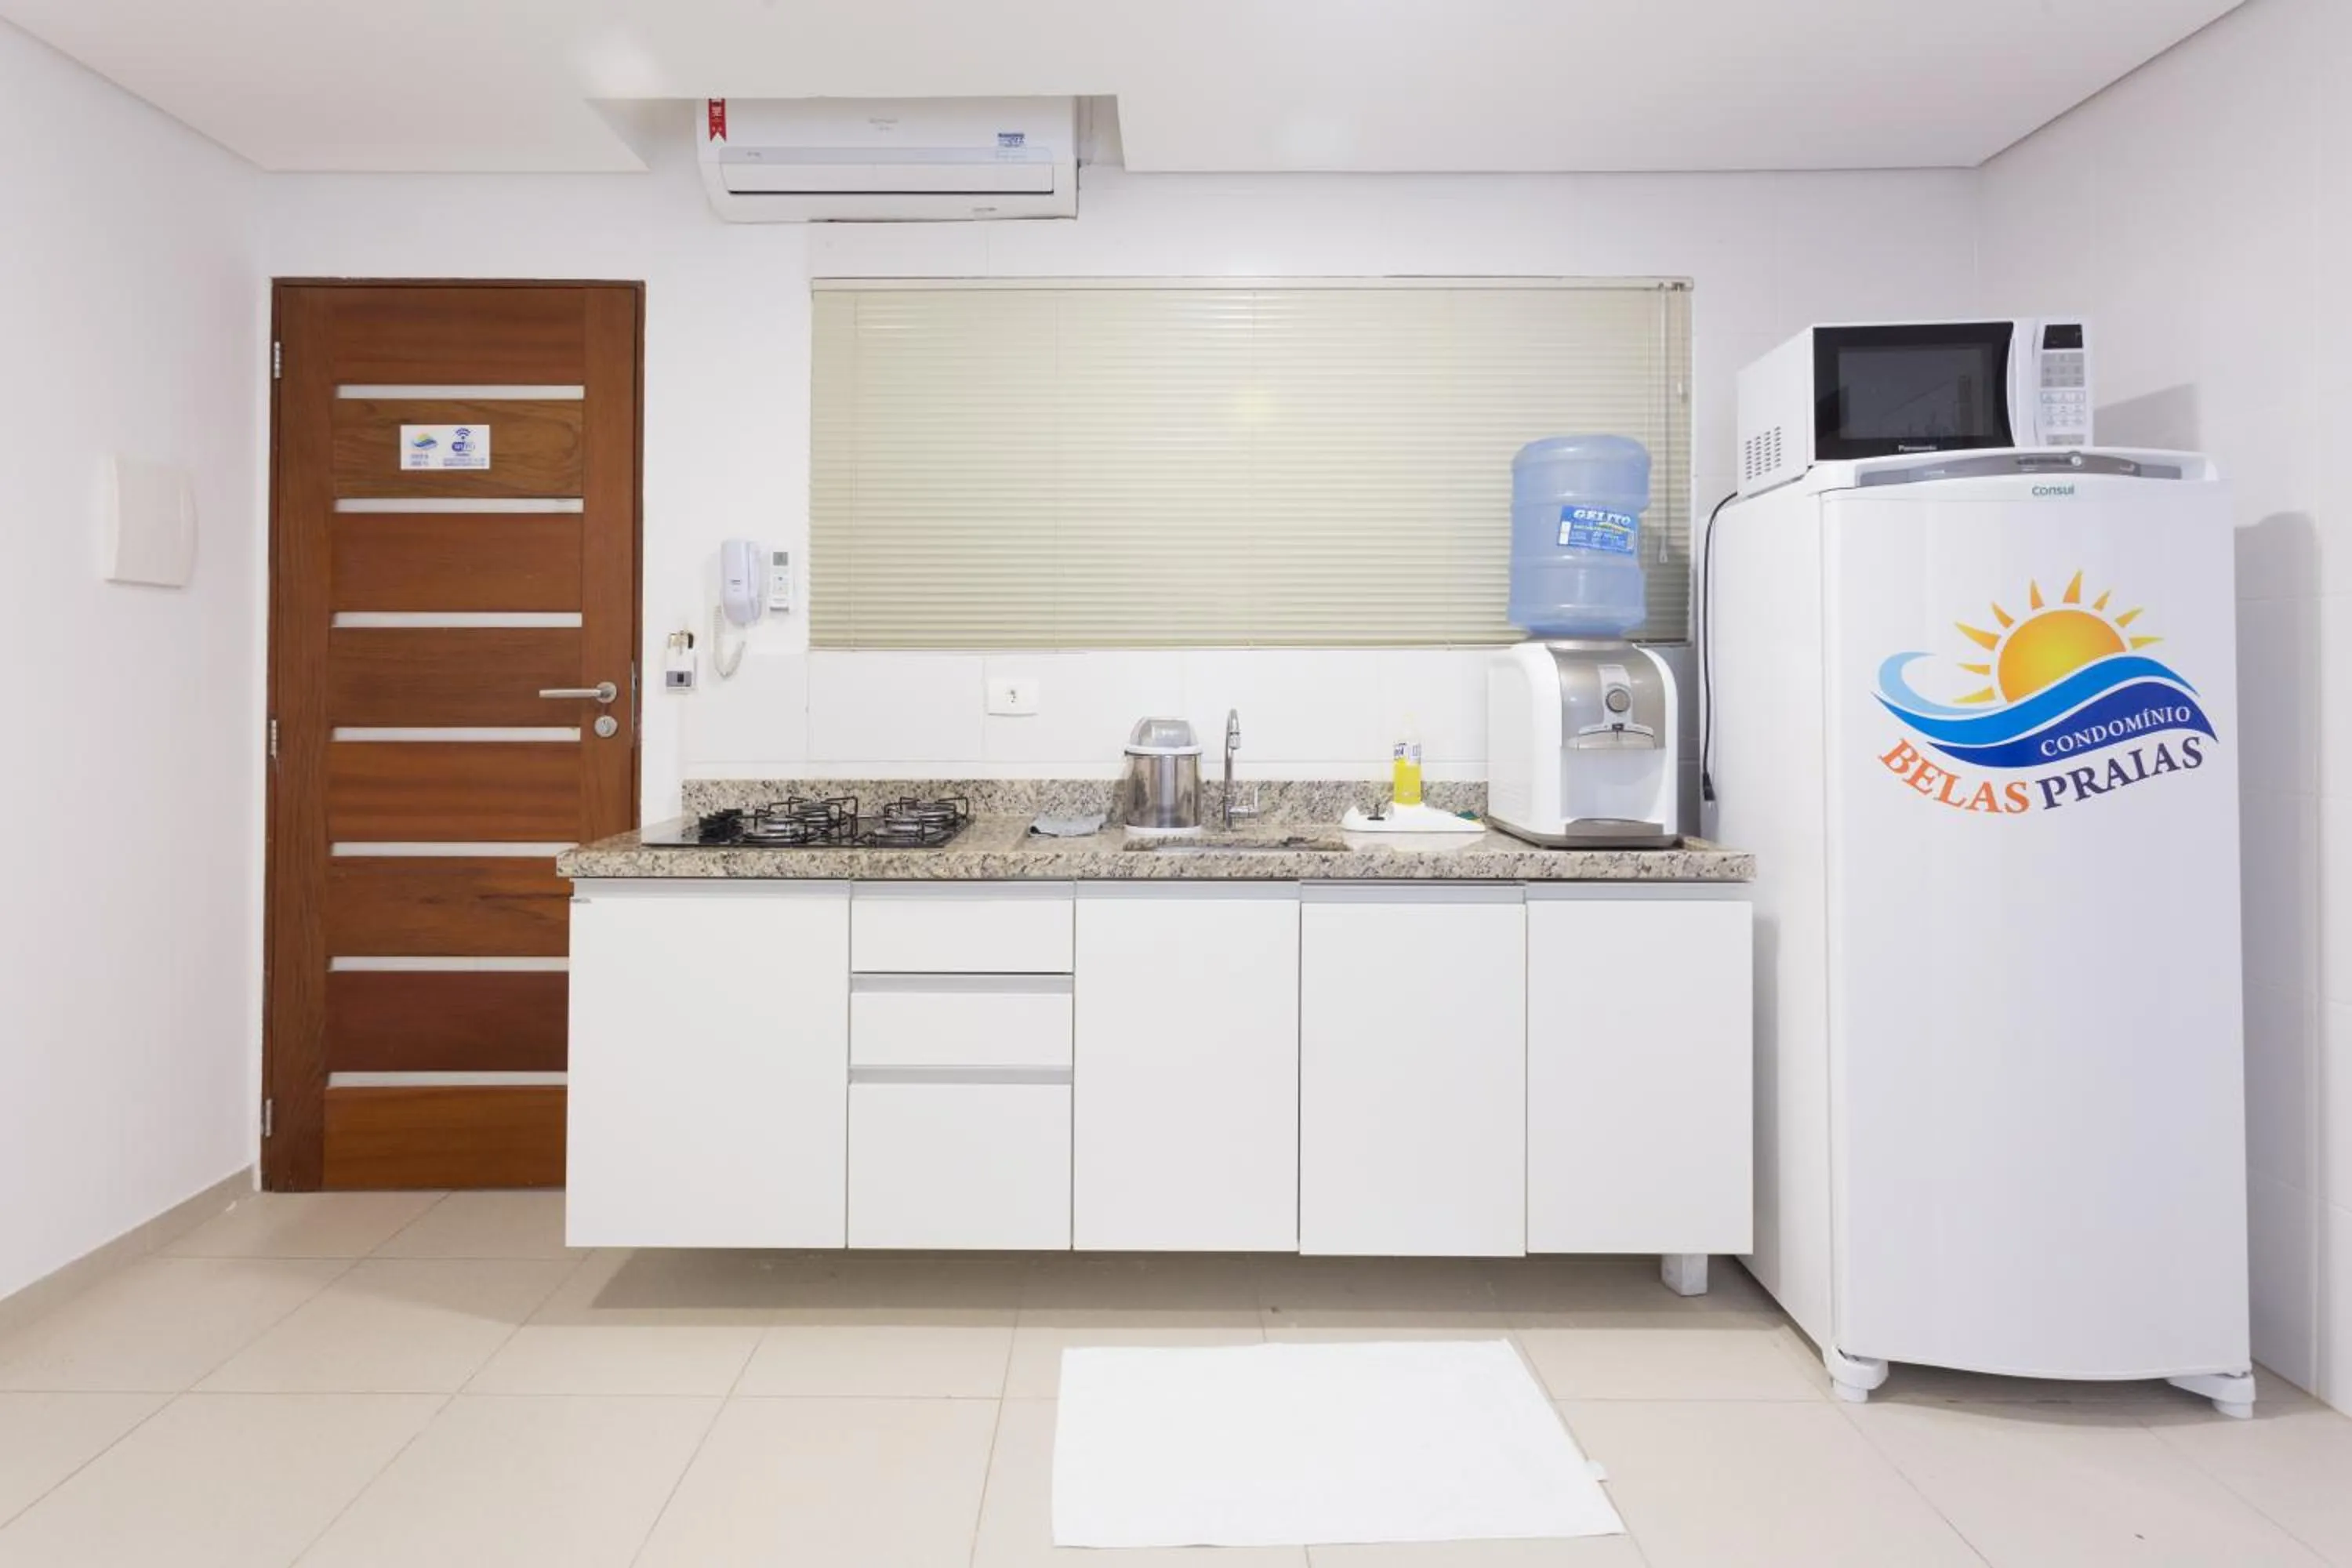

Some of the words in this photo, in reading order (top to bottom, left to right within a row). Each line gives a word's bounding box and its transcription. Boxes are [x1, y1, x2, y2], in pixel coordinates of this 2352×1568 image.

[2041, 706, 2191, 756] CONDOMÍNIO
[1878, 738, 2030, 814] BELAS
[2035, 736, 2204, 810] PRAIAS
